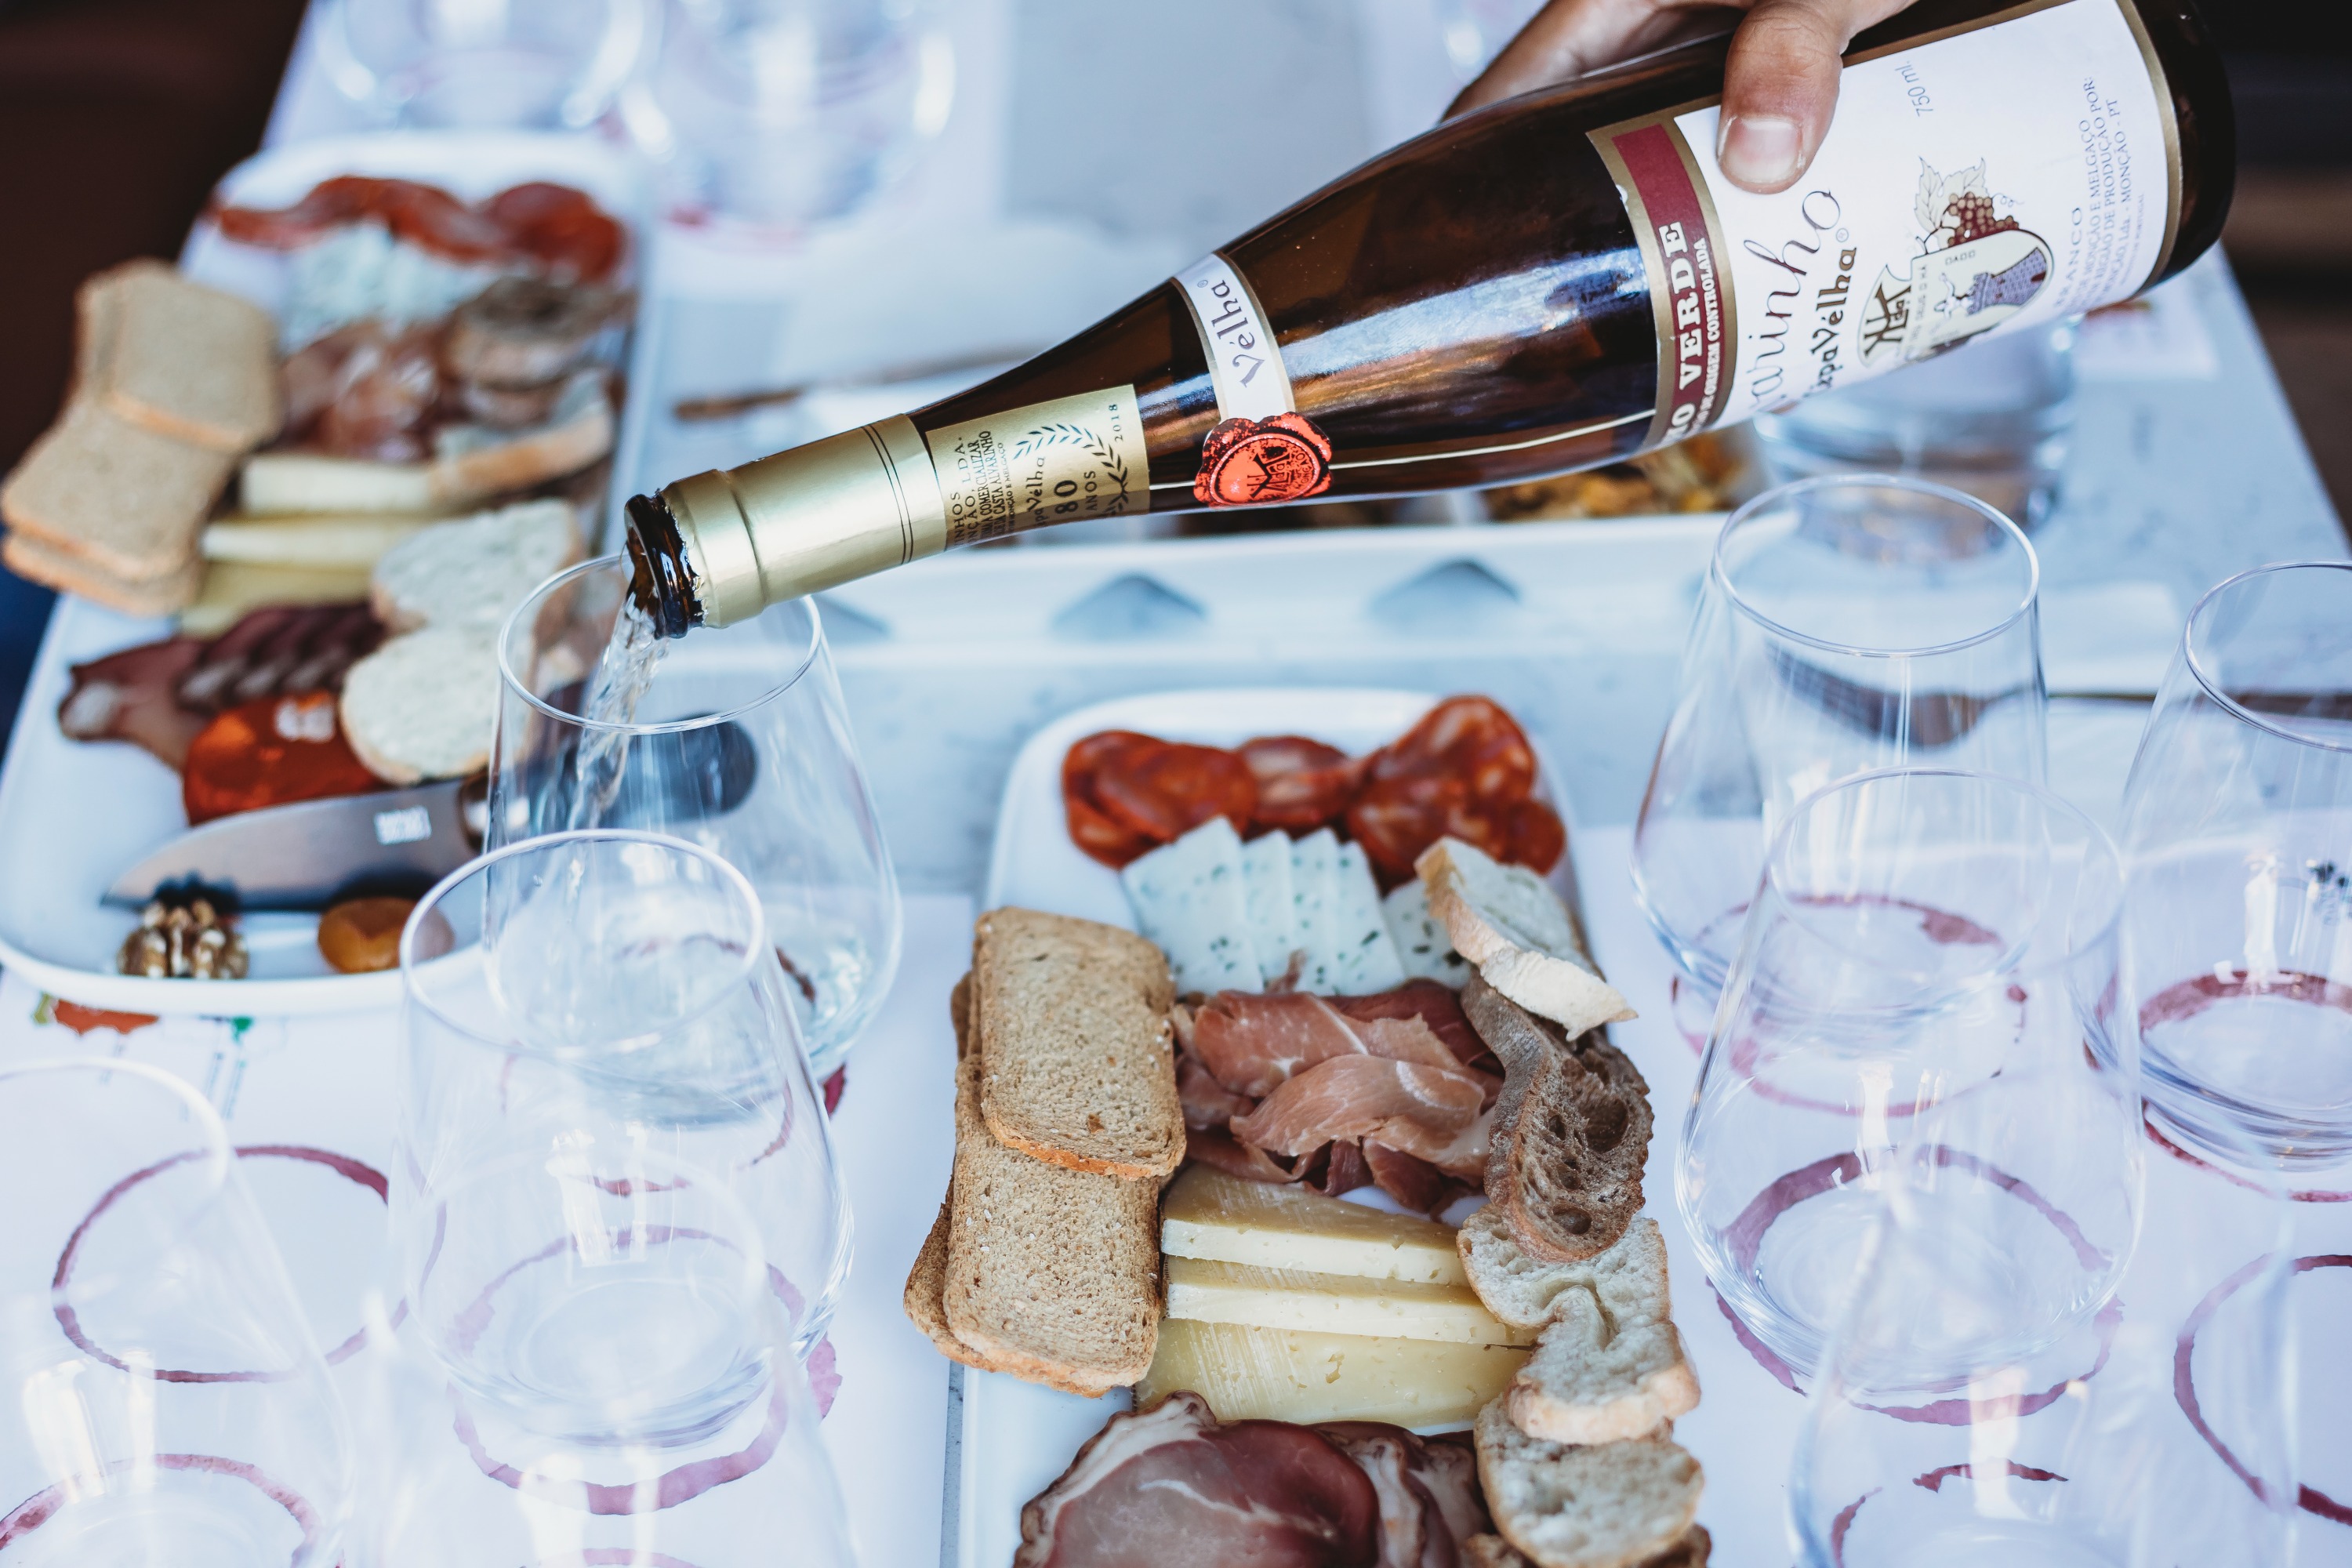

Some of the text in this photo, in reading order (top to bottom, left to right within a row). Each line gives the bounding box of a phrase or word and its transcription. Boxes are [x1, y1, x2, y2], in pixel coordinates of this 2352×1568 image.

[1907, 85, 1934, 118] 750
[2083, 76, 2102, 113] POR:
[2105, 99, 2121, 117] PT
[2078, 119, 2100, 198] MELGAÇO
[2093, 116, 2116, 206] PRODUÇÃO
[2113, 130, 2132, 203] MONÇÃO
[2090, 201, 2101, 212] E
[2103, 210, 2115, 230] DE
[1658, 220, 1703, 390] VERDE
[1695, 237, 1721, 342] CONTROLADA
[1744, 187, 1841, 398] arinho
[1210, 279, 1265, 388] Vélha
[1704, 341, 1721, 396] ORIGEM
[1108, 404, 1124, 442] 2018
[954, 437, 971, 484] LDA.
[967, 439, 993, 517] COMERCIALIZAR
[978, 430, 1003, 485] ALVARINHO
[997, 442, 1011, 481] MELGAÇO
[992, 486, 1006, 515] CASTA
[1053, 480, 1079, 515] 80
[1083, 470, 1098, 511] ANOS
[949, 492, 966, 543] INHOS
